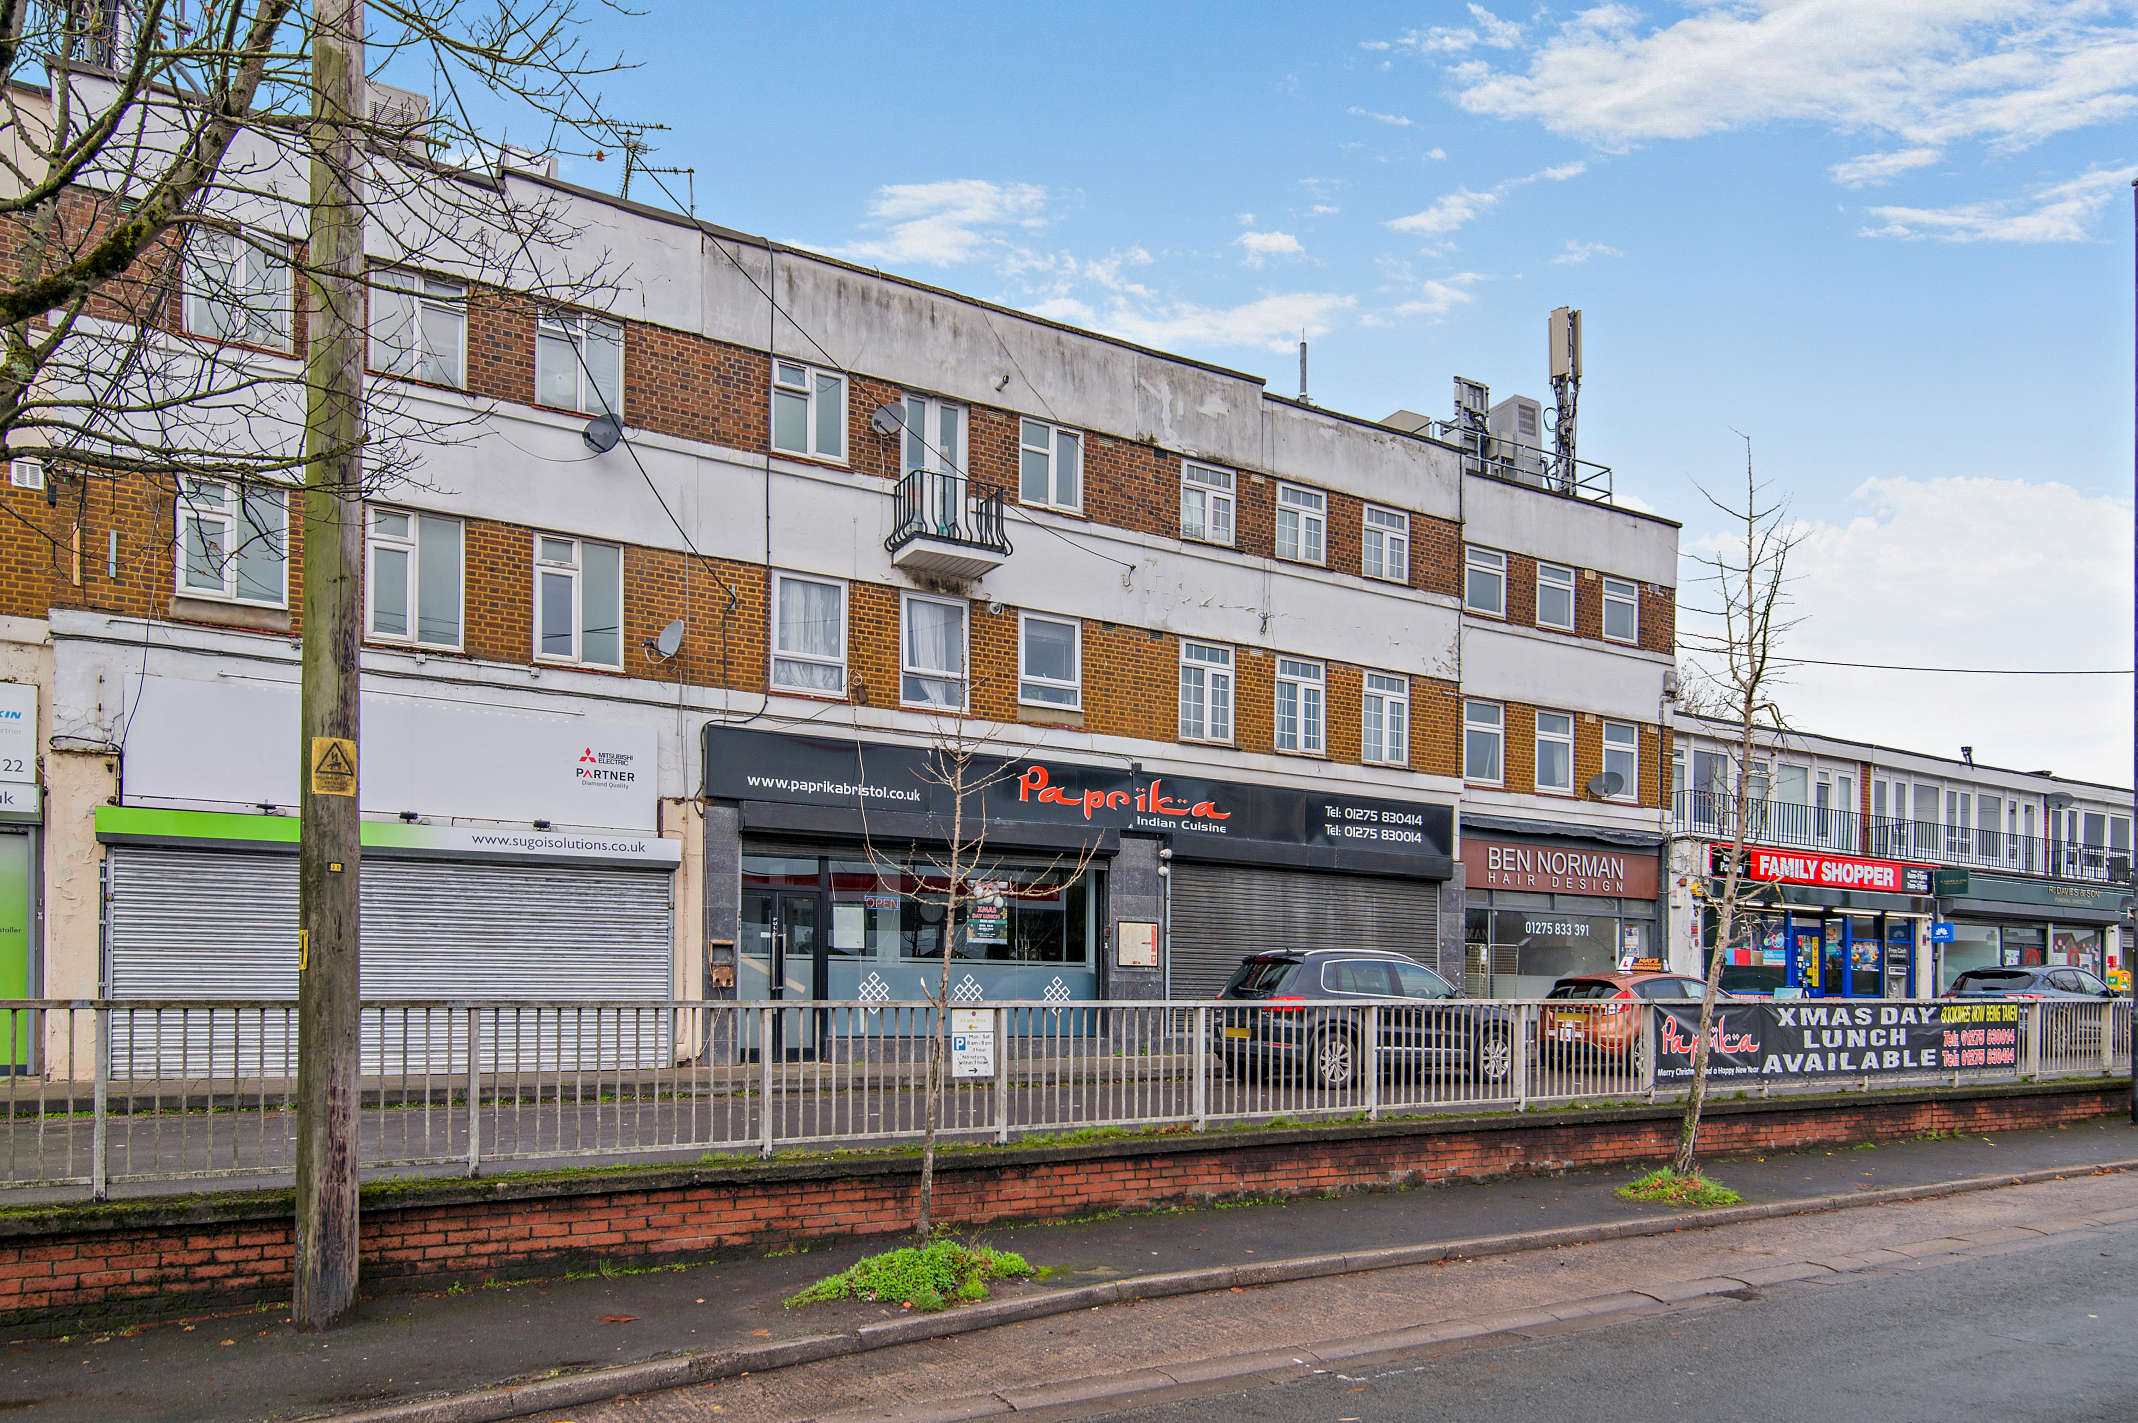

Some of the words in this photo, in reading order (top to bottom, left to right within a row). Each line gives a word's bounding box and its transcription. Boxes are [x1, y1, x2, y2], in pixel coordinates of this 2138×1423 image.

[598, 752, 632, 760] MITSUBISHI
[598, 758, 629, 766] ELECTRIC
[576, 767, 635, 782] PARTNER
[747, 774, 921, 802] www.paprikabristol.co.uk
[1136, 815, 1176, 829] Indian
[1181, 820, 1227, 834] Cuisine
[1325, 805, 1341, 818] Tel:
[1344, 807, 1378, 822] 01275
[1381, 811, 1423, 826] 830414
[1325, 824, 1341, 836] Tel:
[1344, 826, 1378, 839] 01275
[1381, 829, 1423, 843] 830014
[472, 835, 646, 853] www.sugoisolutions.co.uk
[1488, 846, 1531, 872] BEN
[1537, 850, 1624, 880] NORMAN
[1759, 854, 1818, 880] FAMILY
[1821, 862, 1895, 887] SHOPPER
[1488, 871, 1535, 886] HAIR
[1551, 876, 1623, 892] DESIGN
[865, 897, 899, 909] OPEN
[1525, 921, 1552, 935] 01275
[1554, 923, 1572, 936] 833
[1574, 923, 1590, 937] 391
[1777, 1007, 1873, 1027] XMAS
[1880, 1006, 1938, 1025] DAY
[1803, 1028, 1906, 1049] LUNCH
[1961, 1029, 1985, 1046] 01275
[1762, 1049, 1938, 1074] AVAILABLE
[1961, 1049, 1985, 1066] 01275
[1657, 1068, 1675, 1078] Merry
[1718, 1066, 1735, 1076] Happy
[1736, 1065, 1747, 1074] New
[1747, 1065, 1760, 1073] Year
